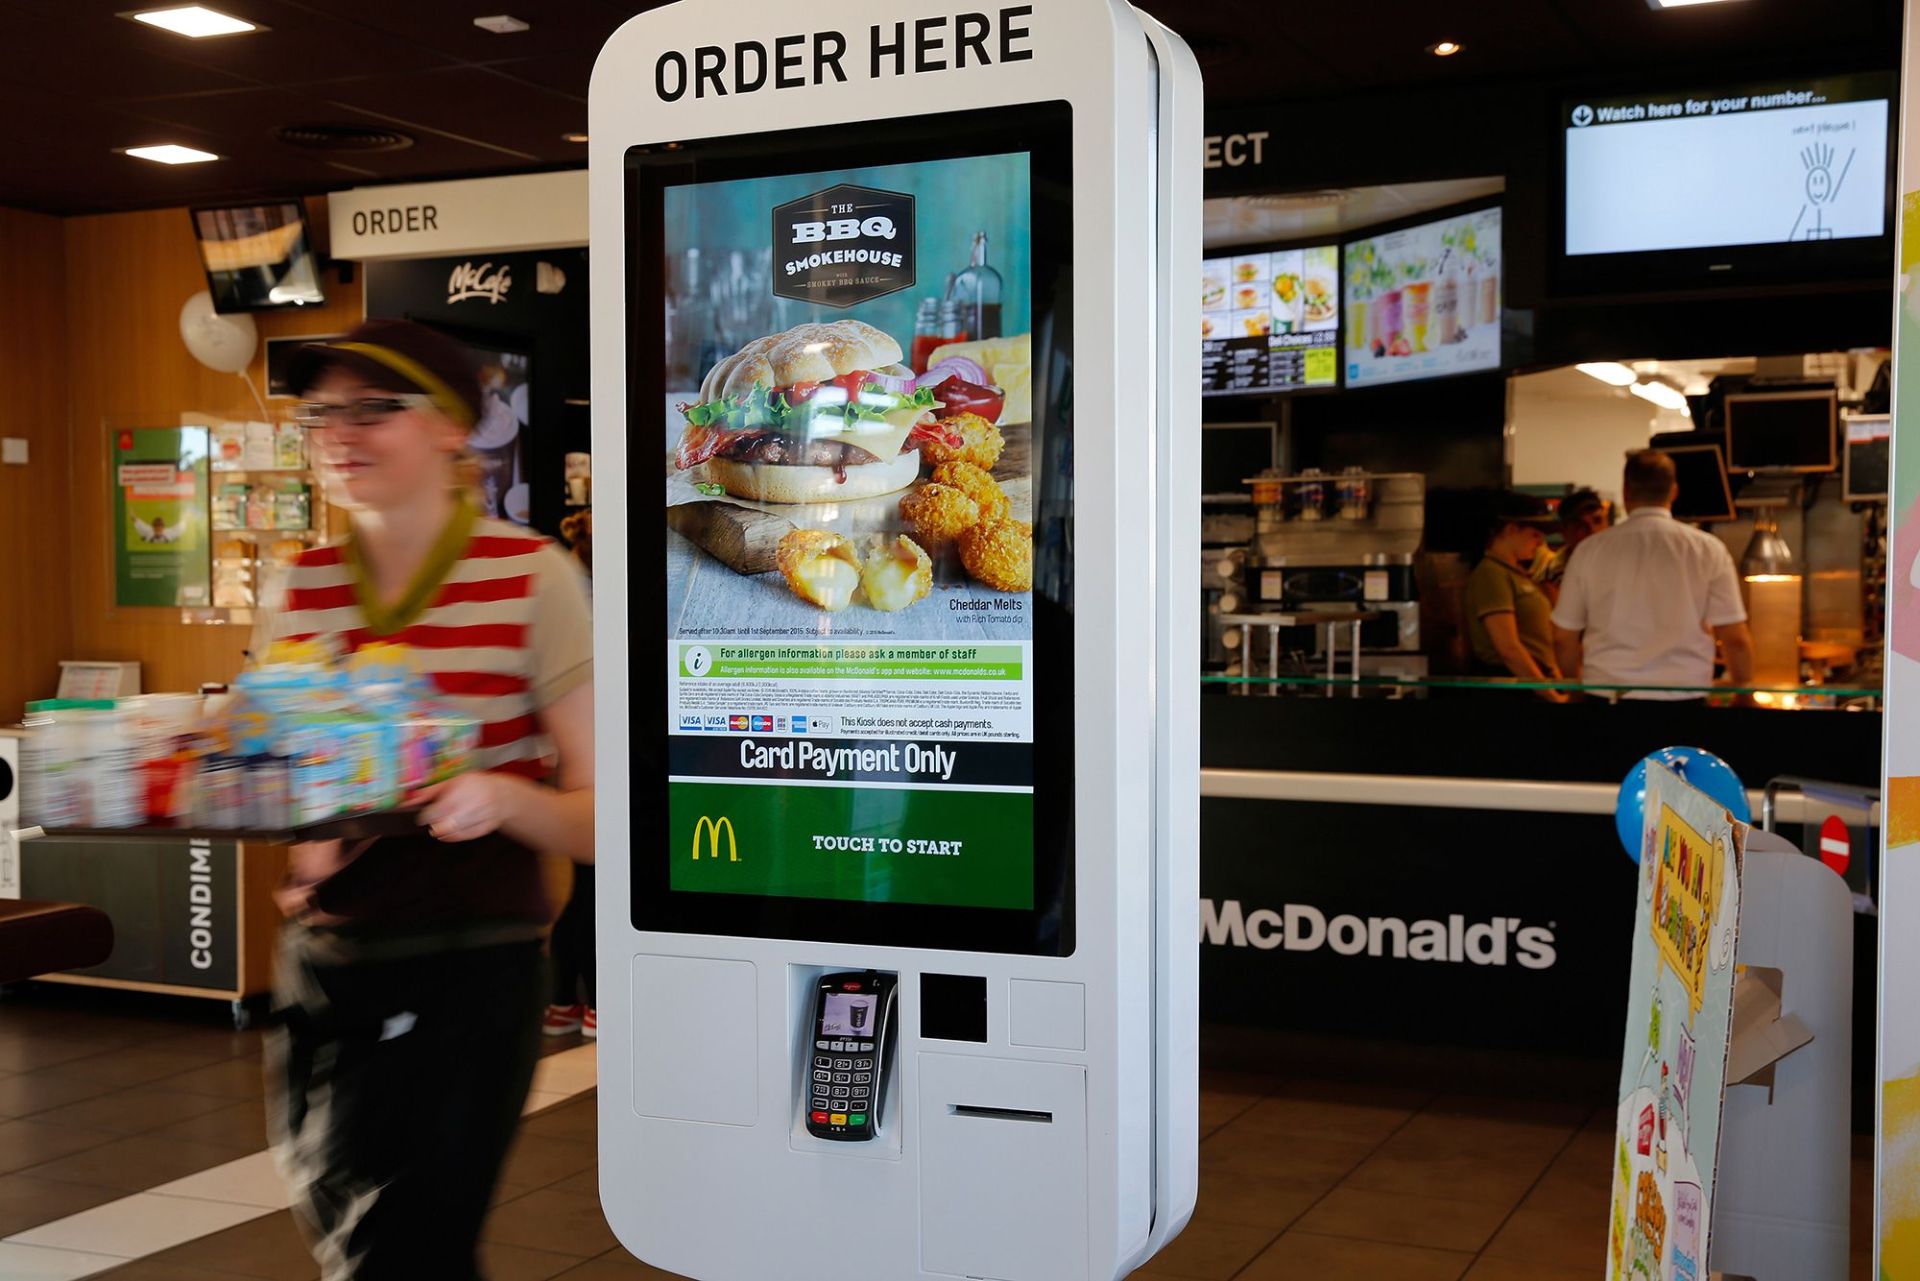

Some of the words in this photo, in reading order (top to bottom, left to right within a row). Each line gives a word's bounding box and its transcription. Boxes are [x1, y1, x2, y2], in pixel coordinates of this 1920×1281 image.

[654, 30, 848, 103] ORDER
[869, 4, 1034, 80] HERE
[1598, 104, 1645, 123] Watch
[1648, 101, 1682, 119] here
[1686, 99, 1708, 115] for
[1711, 96, 1748, 116] your
[1202, 131, 1270, 169] ECT
[831, 203, 854, 214] THE
[352, 204, 439, 236] ORDER
[791, 215, 897, 244] BBQ
[784, 248, 903, 276] SMOKEHOUSE
[838, 278, 854, 286] BBQ
[855, 276, 880, 285] SAUCE
[949, 598, 992, 611] Cheddar
[993, 598, 1023, 611] Melts
[955, 614, 971, 624] with
[972, 614, 986, 624] Rich
[987, 614, 1012, 624] Tomato
[679, 627, 698, 635] Served
[760, 627, 789, 636] September
[720, 648, 736, 658] For
[738, 648, 776, 661] allergen
[778, 648, 833, 659] information
[835, 649, 866, 660] please
[868, 649, 886, 659] ask
[888, 650, 894, 659] a
[896, 649, 937, 659] member
[939, 649, 950, 660] of
[951, 649, 977, 660] staff
[720, 665, 744, 676] Allergen
[745, 666, 780, 674] information
[786, 666, 799, 674] also
[799, 667, 826, 675] available
[682, 716, 701, 725] VISA
[707, 716, 726, 725] VISA
[818, 720, 830, 730] Pay
[840, 716, 856, 727] This
[856, 716, 877, 727] Kiosk
[877, 717, 895, 727] does
[895, 717, 908, 728] not
[908, 718, 934, 729] accept
[934, 718, 953, 728] cash
[953, 719, 994, 731] payments.
[740, 739, 794, 770] Card
[798, 740, 900, 777] Payment
[904, 742, 957, 781] Only
[812, 834, 875, 853] TOUCH
[878, 838, 902, 854] TO
[906, 839, 963, 856] START
[189, 838, 212, 970] CONDIM
[1198, 898, 1557, 970] McDonald's
